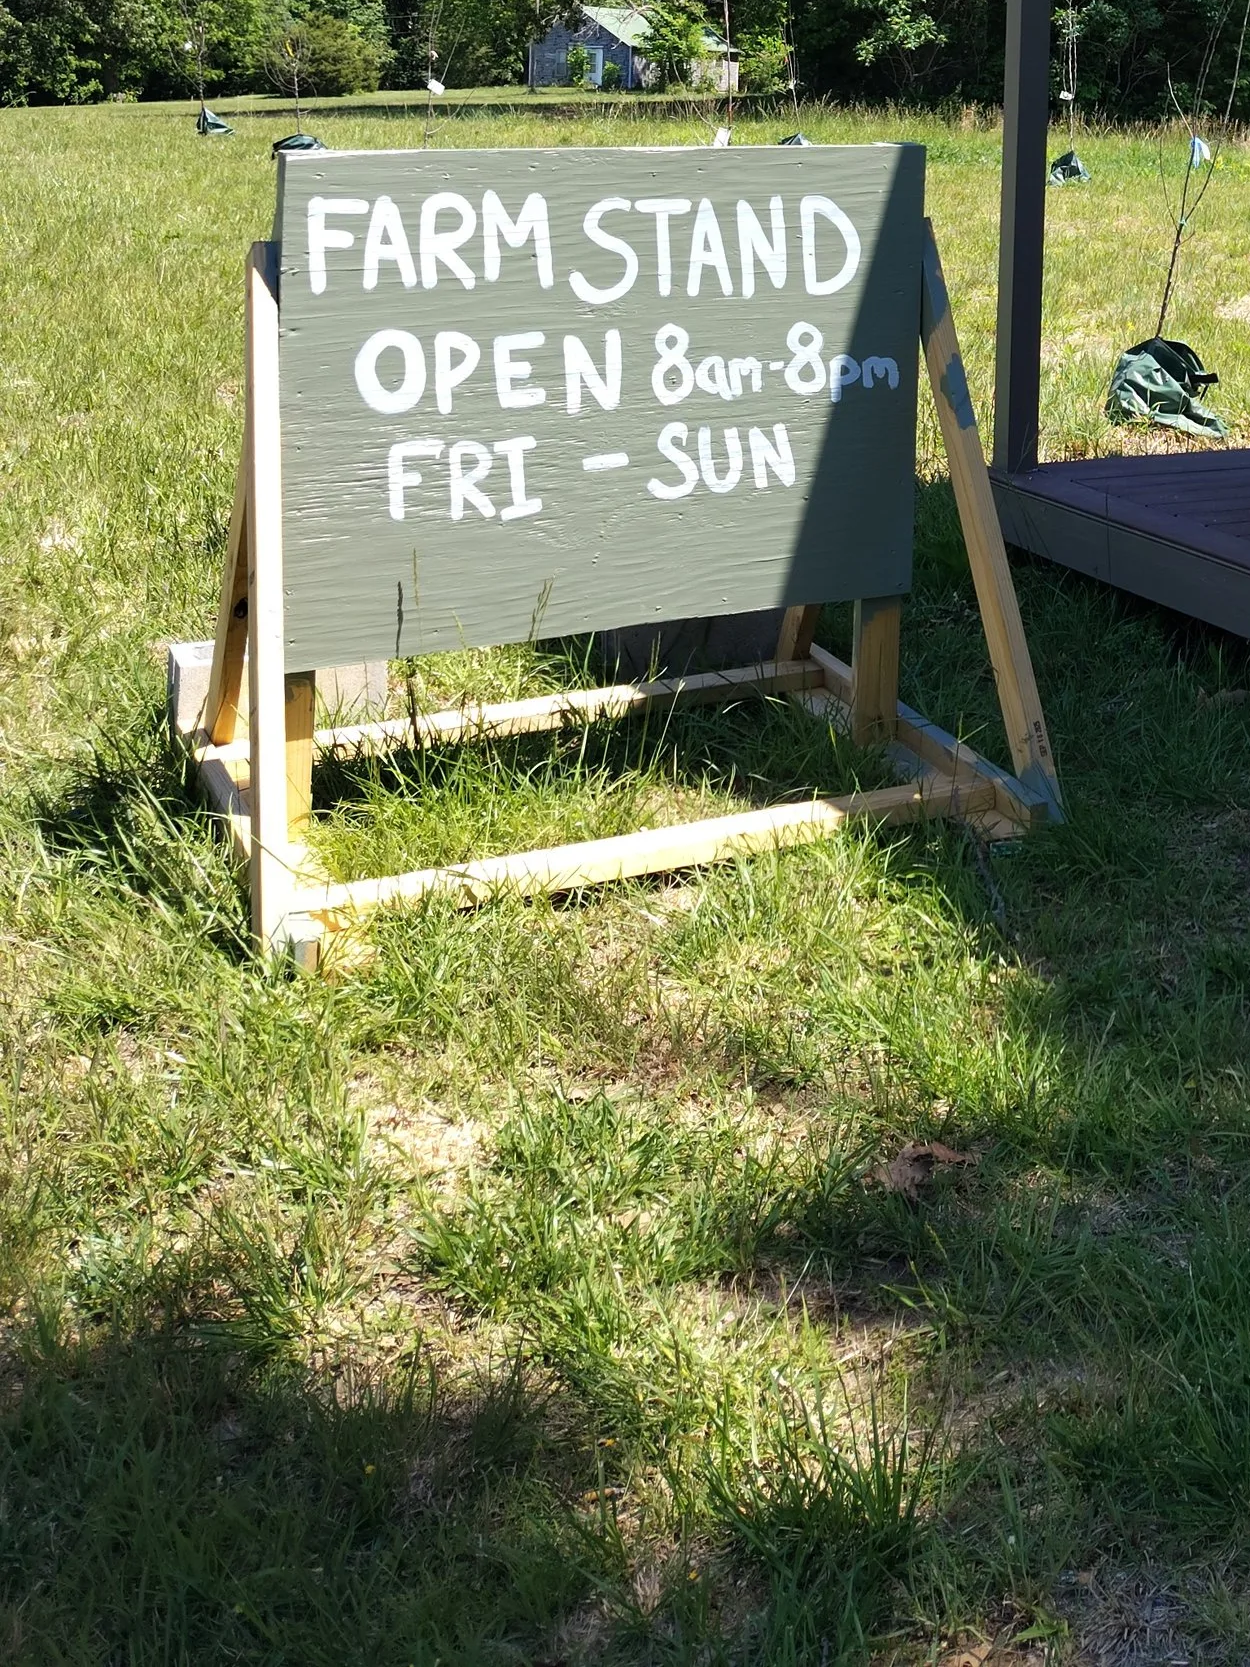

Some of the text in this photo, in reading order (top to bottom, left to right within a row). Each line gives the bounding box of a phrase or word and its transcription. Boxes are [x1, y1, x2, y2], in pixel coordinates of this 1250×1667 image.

[307, 189, 863, 305] FARM STAND
[354, 321, 899, 415] OPEN 8am-8pm
[387, 437, 544, 521] FRI
[646, 421, 797, 501] SUN
